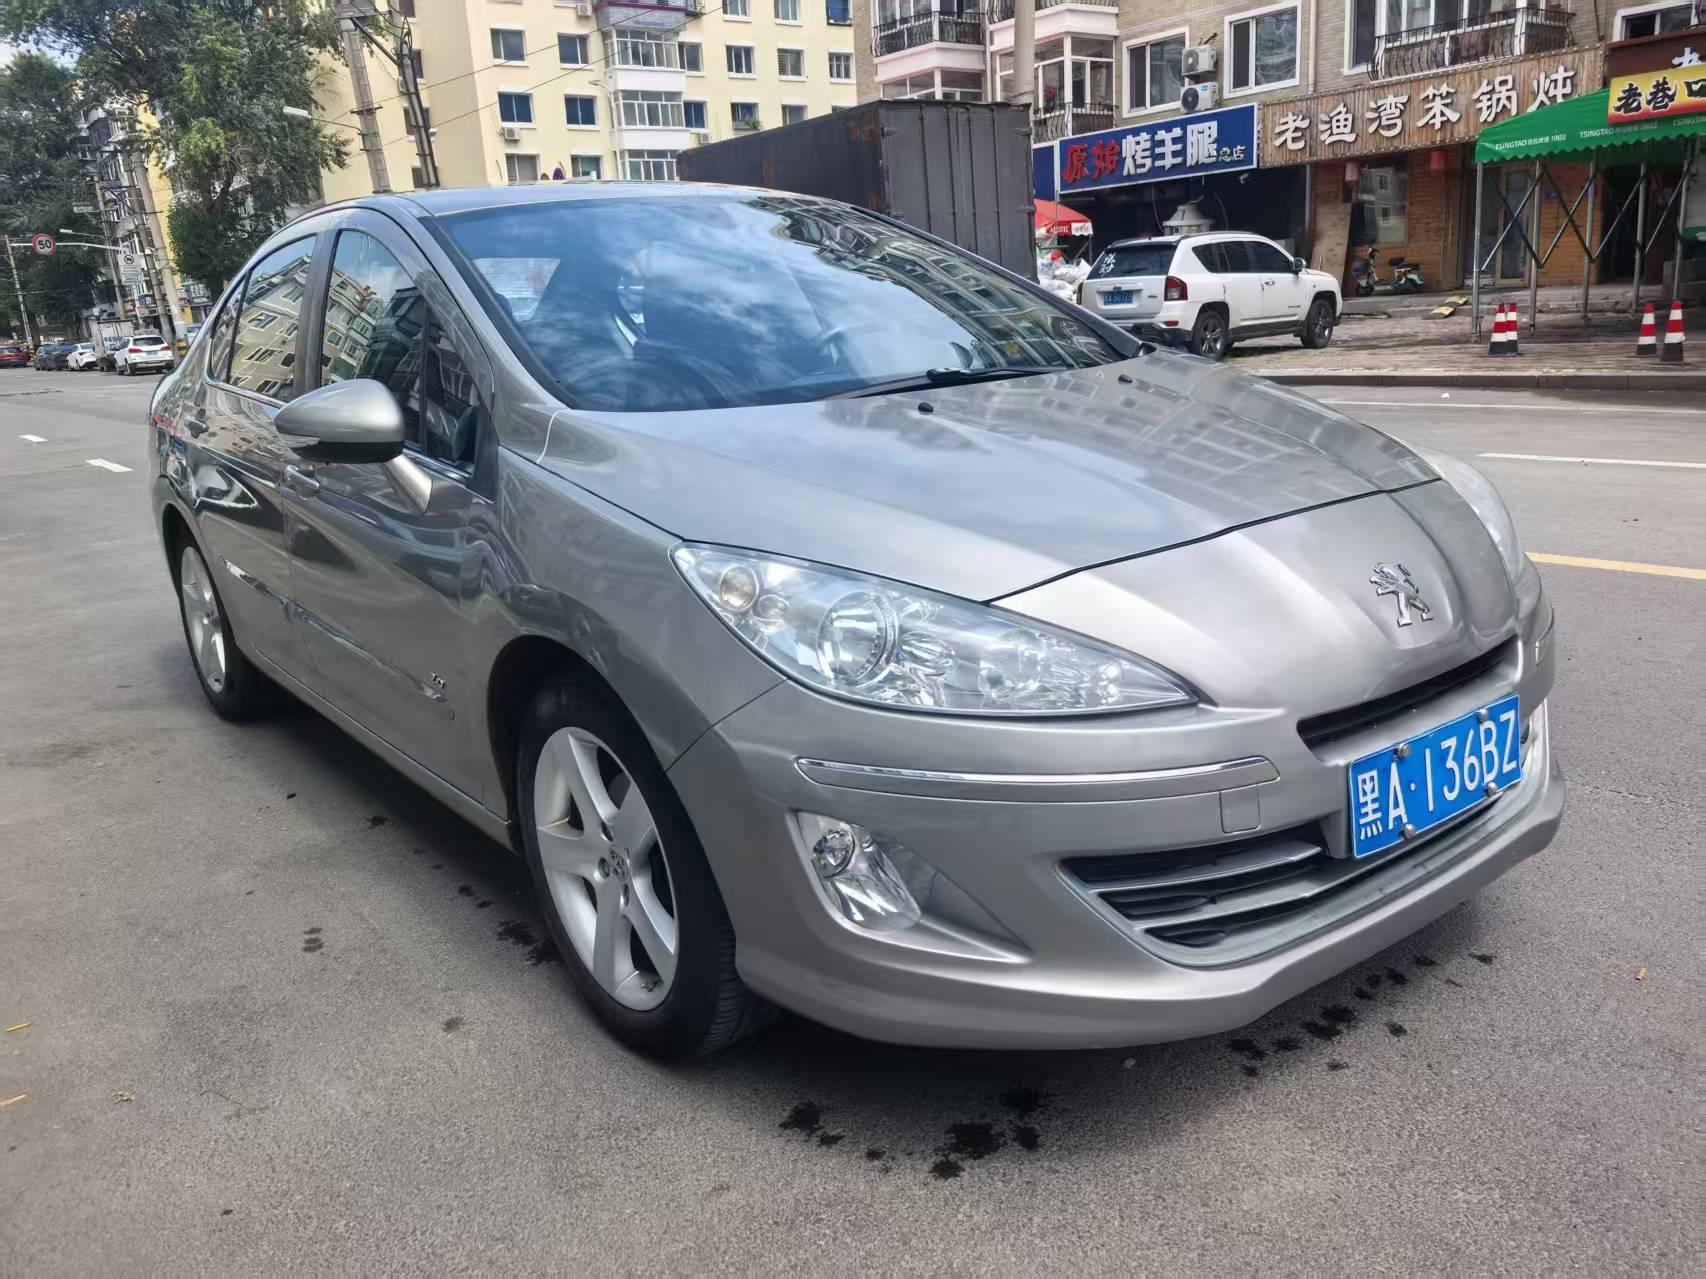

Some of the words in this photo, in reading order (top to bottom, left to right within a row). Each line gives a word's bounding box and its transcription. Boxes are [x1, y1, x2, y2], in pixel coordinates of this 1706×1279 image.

[1273, 65, 1576, 150] 老渔湾笨锅炖
[38, 239, 52, 250] 50
